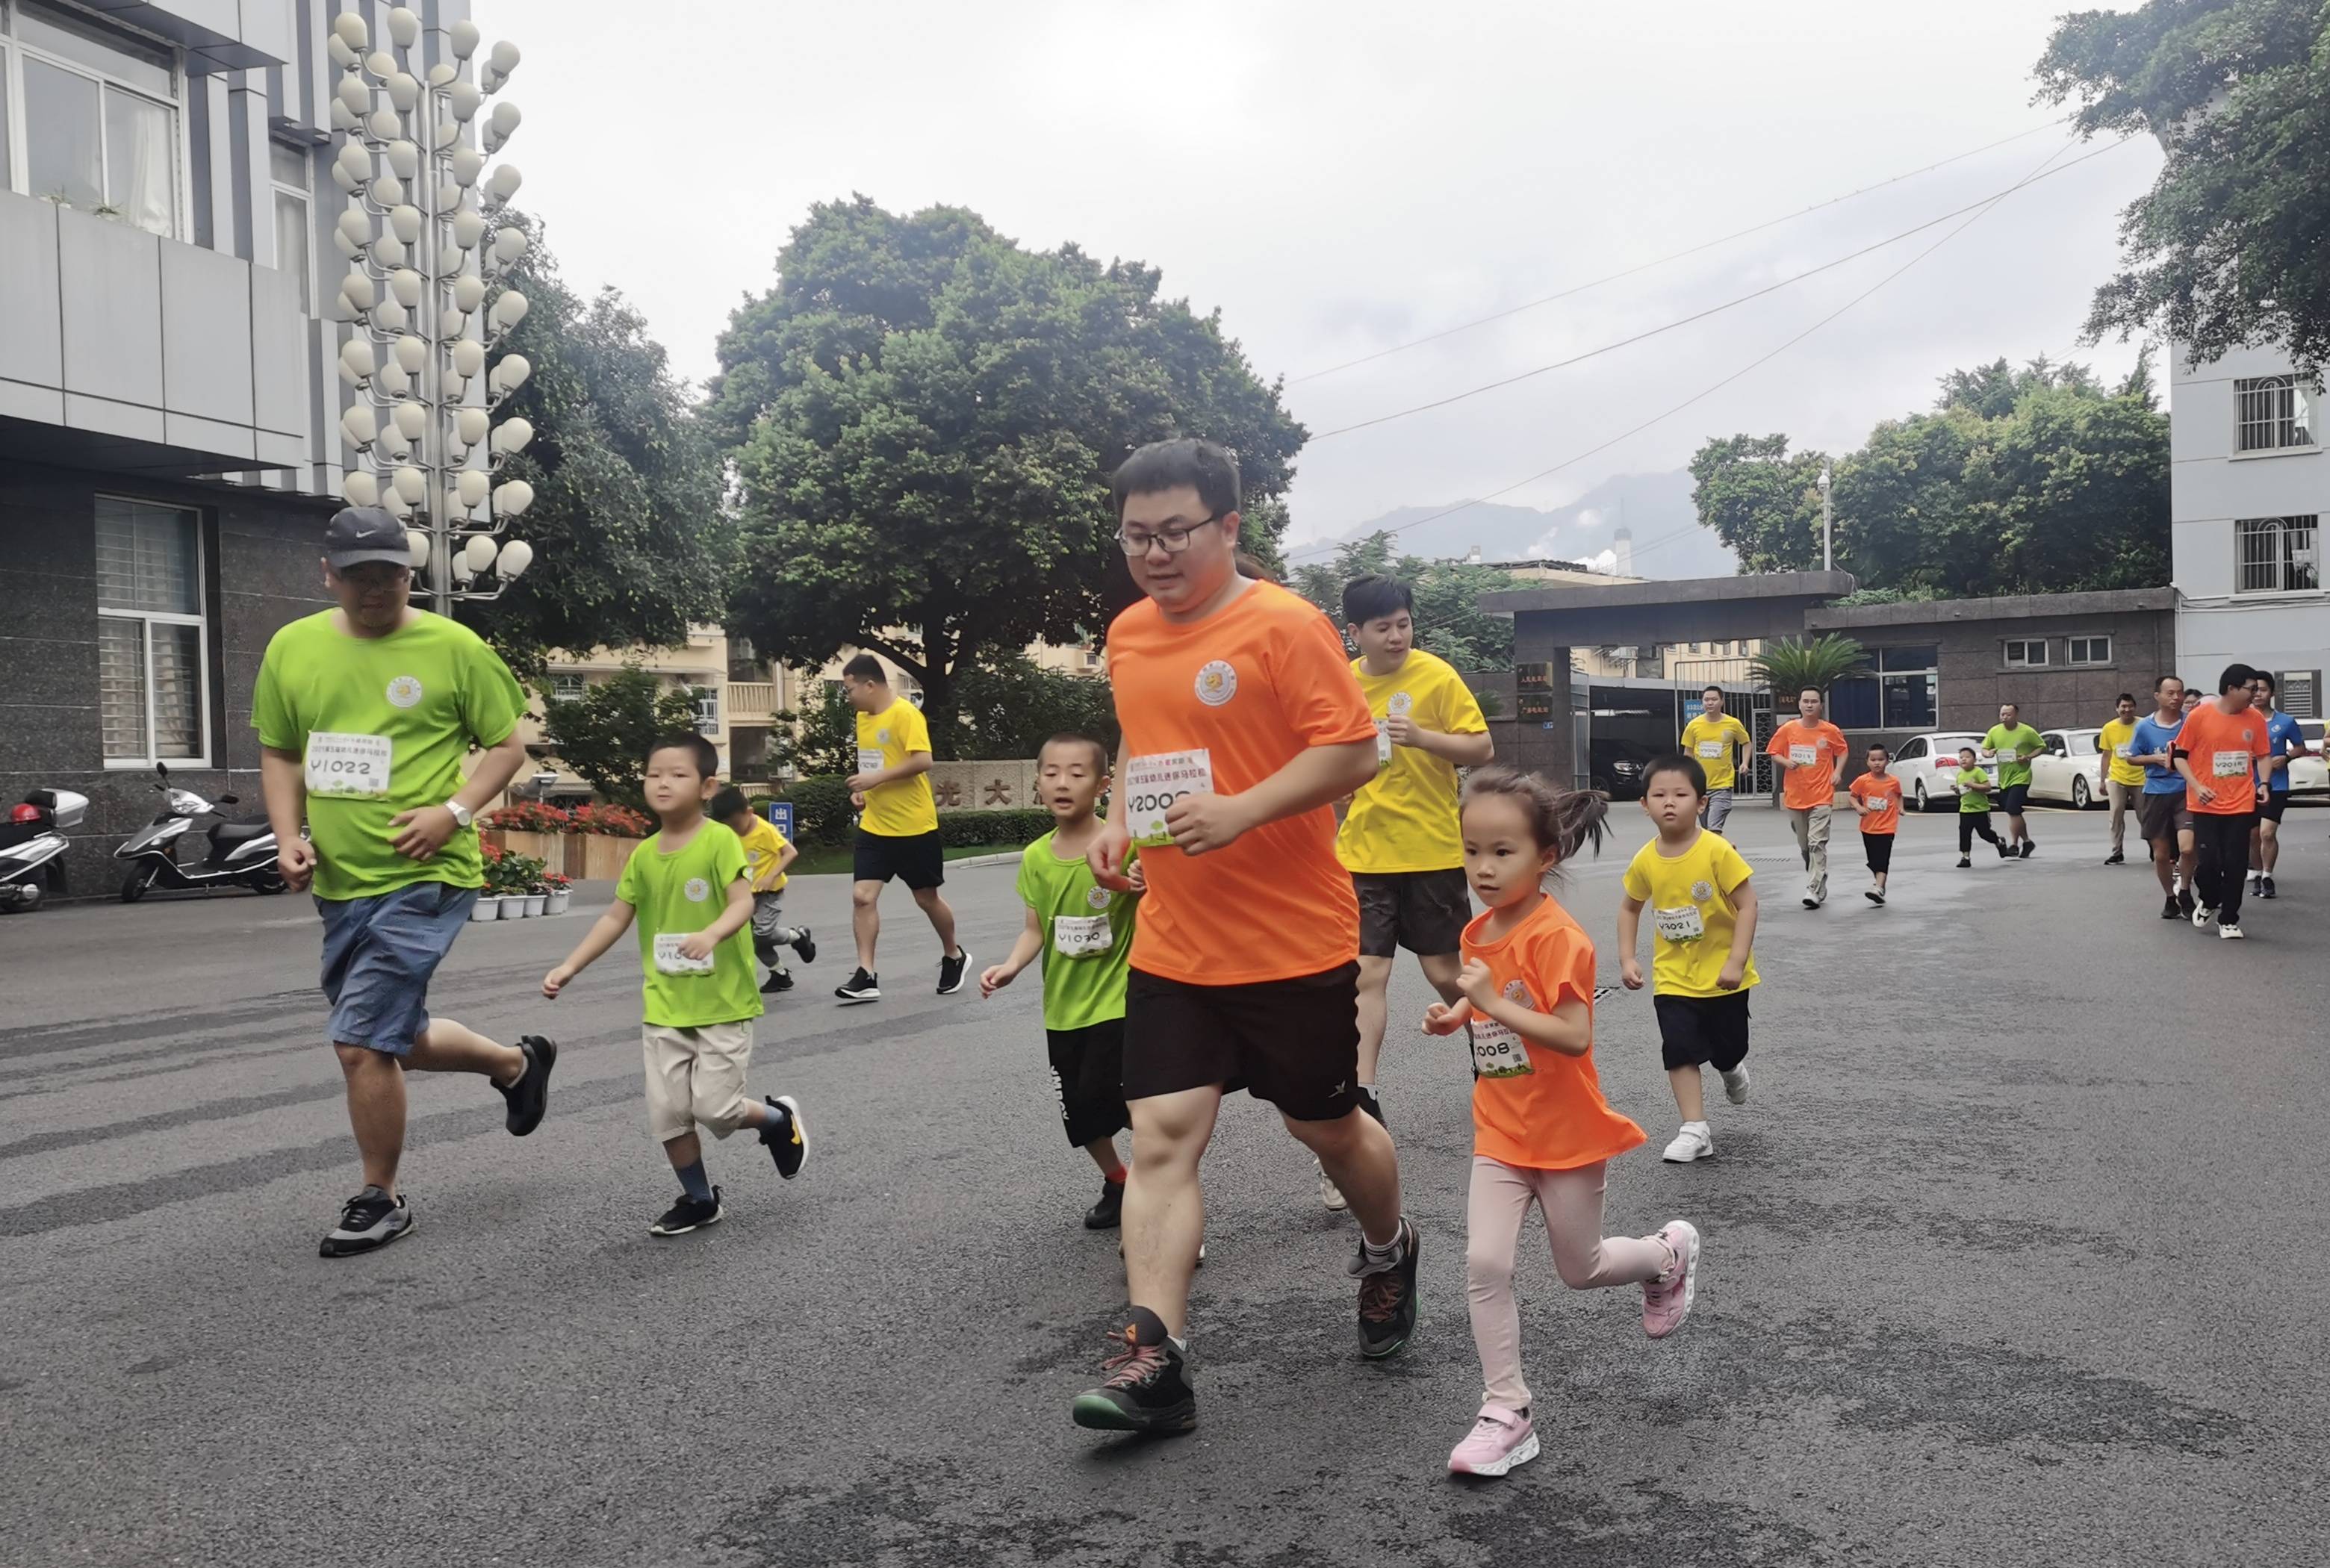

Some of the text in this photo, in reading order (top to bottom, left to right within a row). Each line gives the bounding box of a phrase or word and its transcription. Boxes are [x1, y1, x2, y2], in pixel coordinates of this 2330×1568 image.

[311, 759, 370, 774] Y1022
[936, 780, 1044, 806] 光大
[1128, 791, 1190, 812] Y200
[775, 807, 786, 834] 出口
[1476, 1042, 1510, 1057] 008
